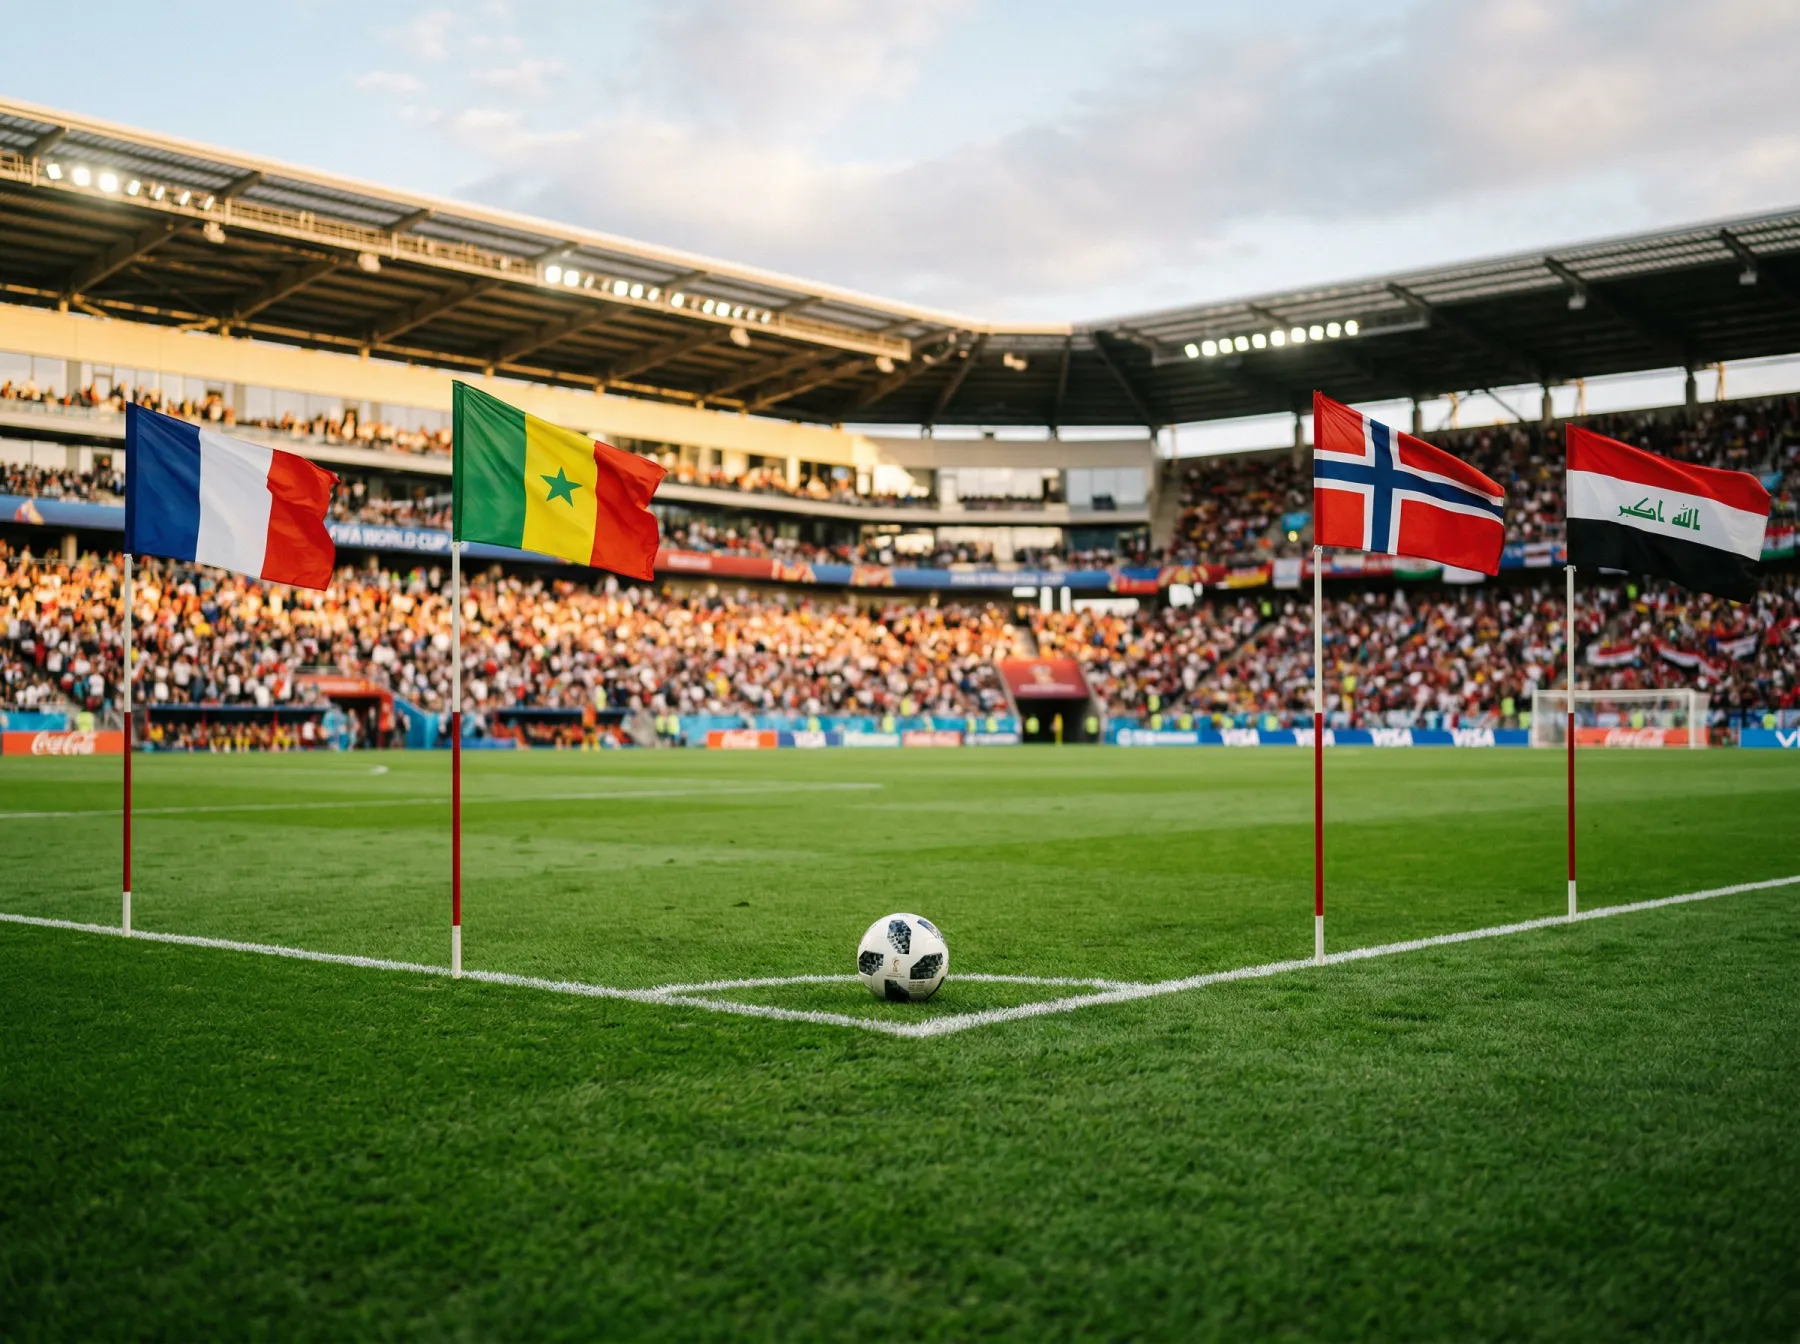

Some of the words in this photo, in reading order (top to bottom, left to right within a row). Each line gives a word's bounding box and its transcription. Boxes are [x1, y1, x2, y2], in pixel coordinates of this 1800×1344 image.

[362, 528, 416, 550] WORLD
[417, 532, 448, 552] CUP
[1219, 728, 1260, 747] VISA
[1292, 728, 1335, 747] VIA
[1369, 728, 1414, 747] VISA
[1450, 728, 1496, 747] VISA
